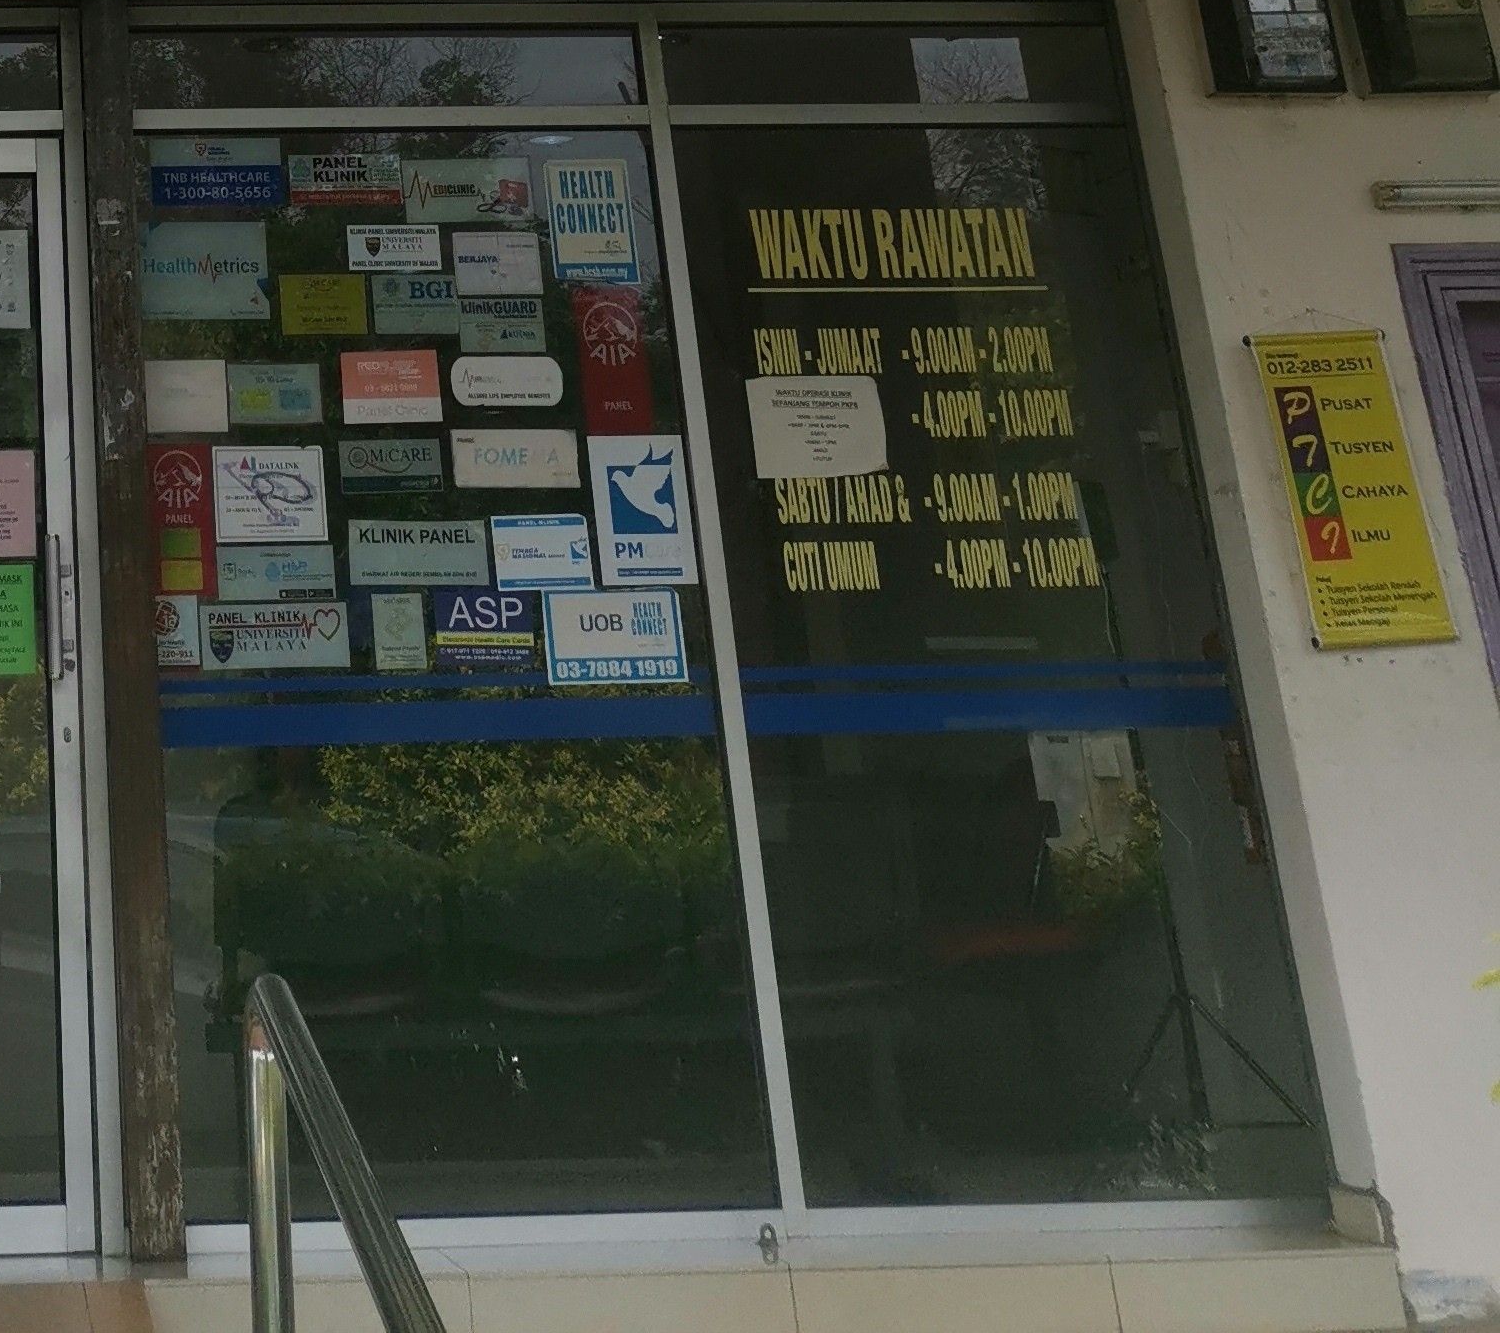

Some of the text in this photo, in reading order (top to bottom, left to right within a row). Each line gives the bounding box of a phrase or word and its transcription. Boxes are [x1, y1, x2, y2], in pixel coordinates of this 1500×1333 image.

[312, 156, 368, 168] PANEL
[163, 172, 270, 184] TNB HEALTHCARE
[313, 170, 368, 183] KLINIK
[558, 170, 616, 199] HEALTH
[164, 186, 272, 199] 1-300-80-5656
[556, 203, 625, 234] CONNECT
[748, 207, 1035, 279] WAKTU RAWATAN
[458, 255, 499, 264] BERJAYA
[143, 252, 260, 285] HealthMetrics
[408, 280, 454, 299] BGI
[460, 300, 537, 314] klinikGUARD
[590, 343, 637, 366] AIA
[754, 327, 1053, 375] ISNIN JUMAAT 9.00AM 2.00PM
[1267, 357, 1373, 375] 012-283 2511
[604, 400, 633, 411] PANEL
[1320, 398, 1373, 411] PUSAT
[923, 389, 1074, 438] 4.00PM 10.00PM
[473, 447, 560, 465] FOMEA
[1330, 441, 1395, 455] TUSYEN
[259, 462, 299, 470] DATALINK
[158, 488, 200, 508] AIA
[774, 472, 1079, 524] SABTU AHAD & 9.00AM 1.00PM
[1342, 484, 1409, 499] CAHAYA
[165, 513, 194, 524] PANEL
[359, 528, 476, 544] KLINIK PANEL
[1351, 529, 1391, 543] ILMU
[783, 538, 1100, 591] CUTI UMUM 4.00PM 10.00PM
[209, 610, 301, 624] PANEL KLINIK
[448, 596, 523, 629] ASP
[632, 602, 662, 618] HEALTH
[580, 613, 624, 632] UOB
[631, 618, 667, 635] CONNECT
[236, 628, 307, 639] UNIVERSITI
[237, 640, 307, 652] MALAYA
[556, 659, 678, 679] 03-7884 1919
